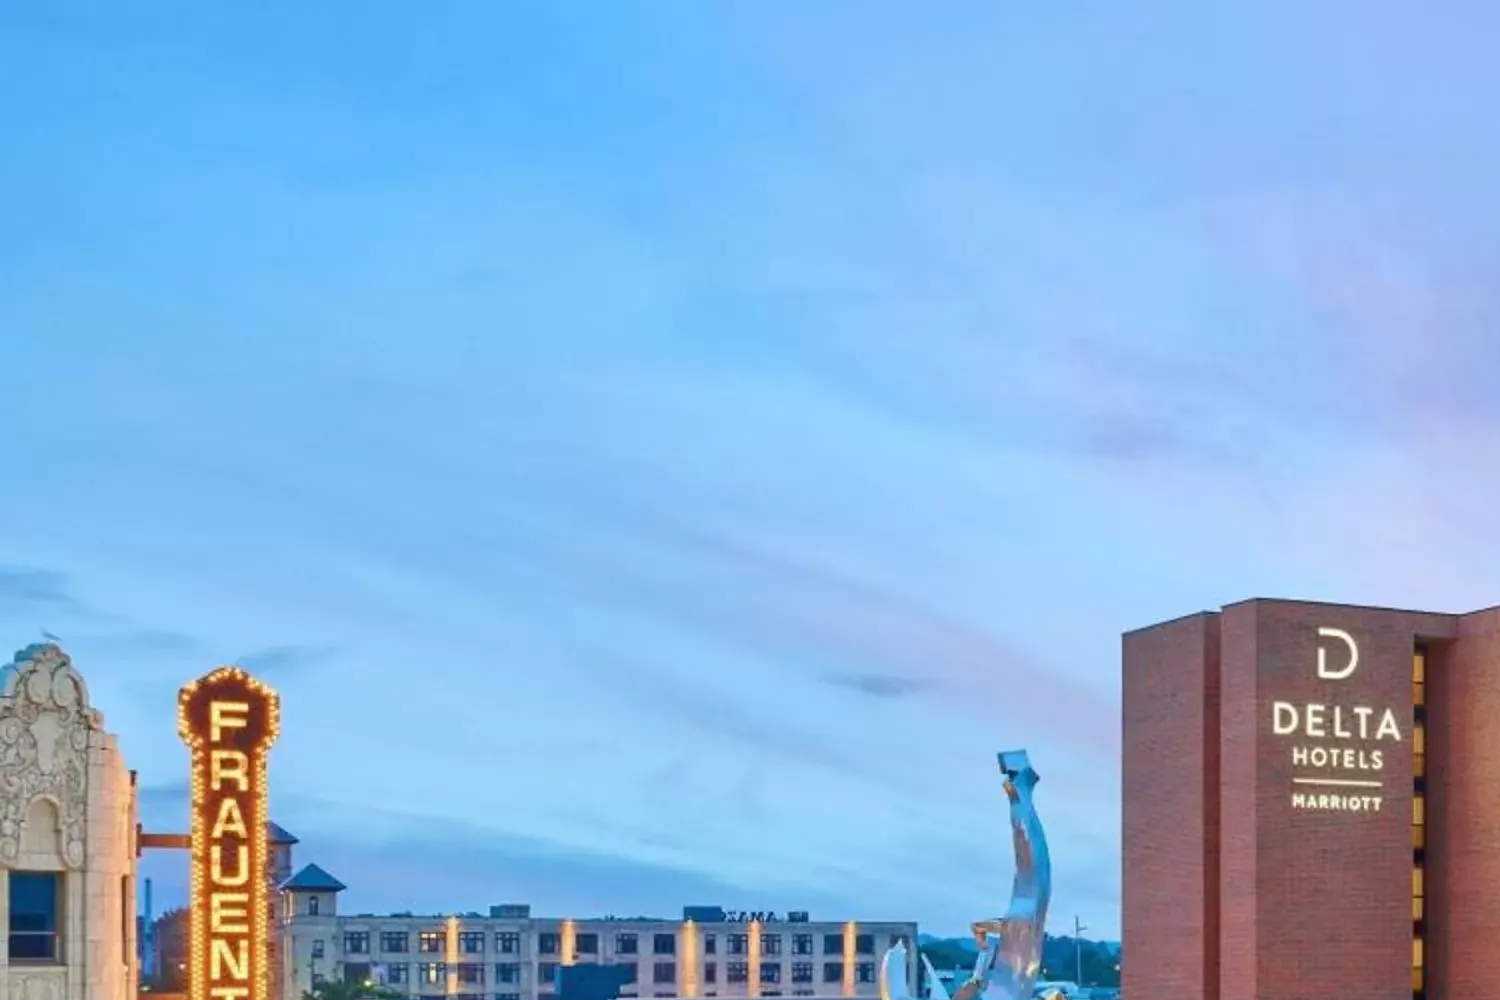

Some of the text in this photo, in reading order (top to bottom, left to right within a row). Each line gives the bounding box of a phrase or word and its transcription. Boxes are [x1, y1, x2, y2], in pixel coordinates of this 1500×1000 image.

[1272, 701, 1402, 742] DELTA
[1292, 747, 1384, 770] HOTELS
[1291, 793, 1384, 812] MARRIOTT
